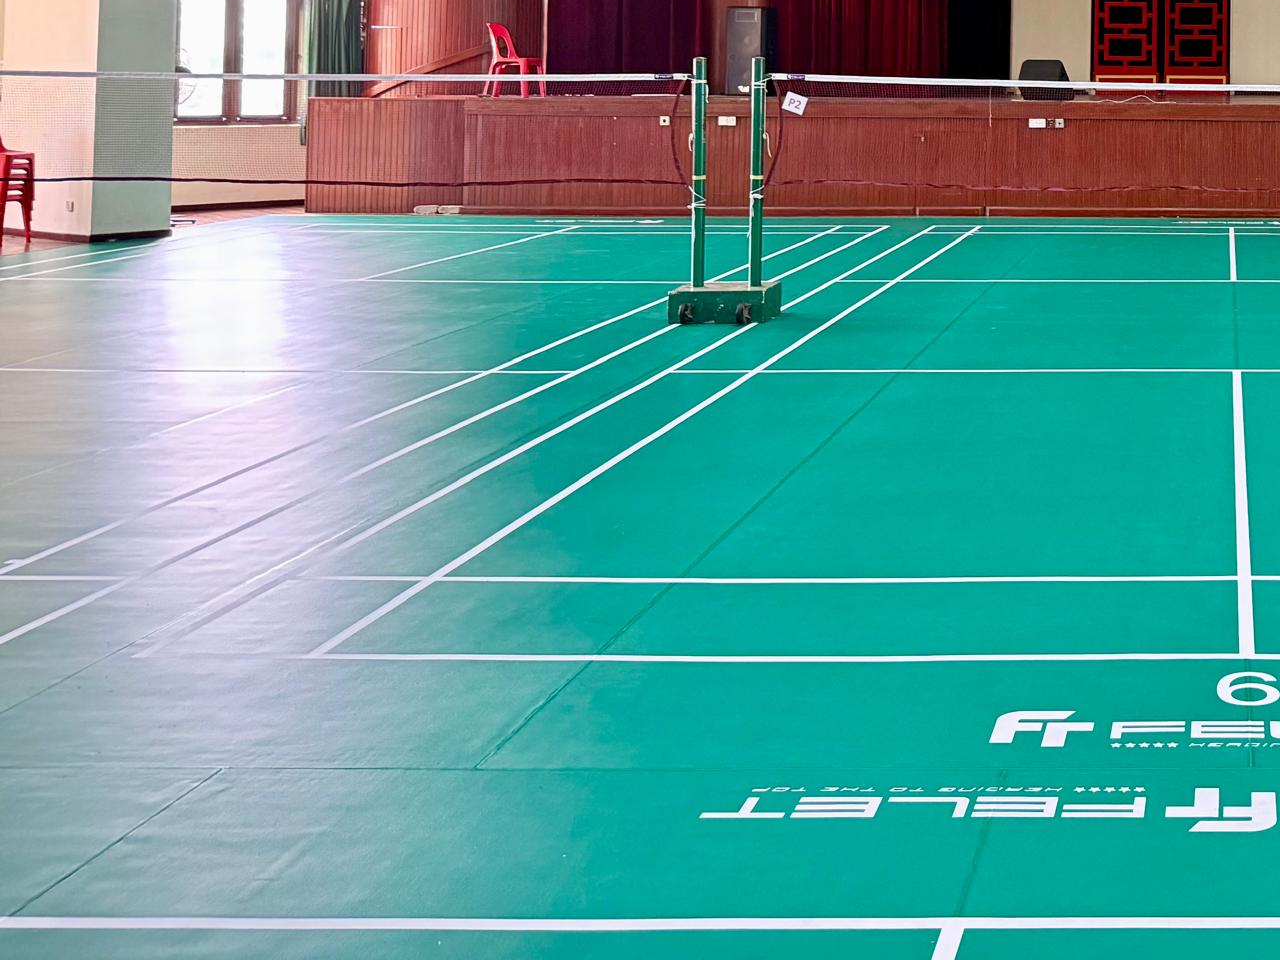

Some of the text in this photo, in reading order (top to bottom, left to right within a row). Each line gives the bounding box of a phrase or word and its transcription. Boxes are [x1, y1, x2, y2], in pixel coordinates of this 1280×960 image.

[787, 97, 802, 110] P2
[1216, 671, 1280, 707] 6
[699, 796, 1147, 819] FELET
